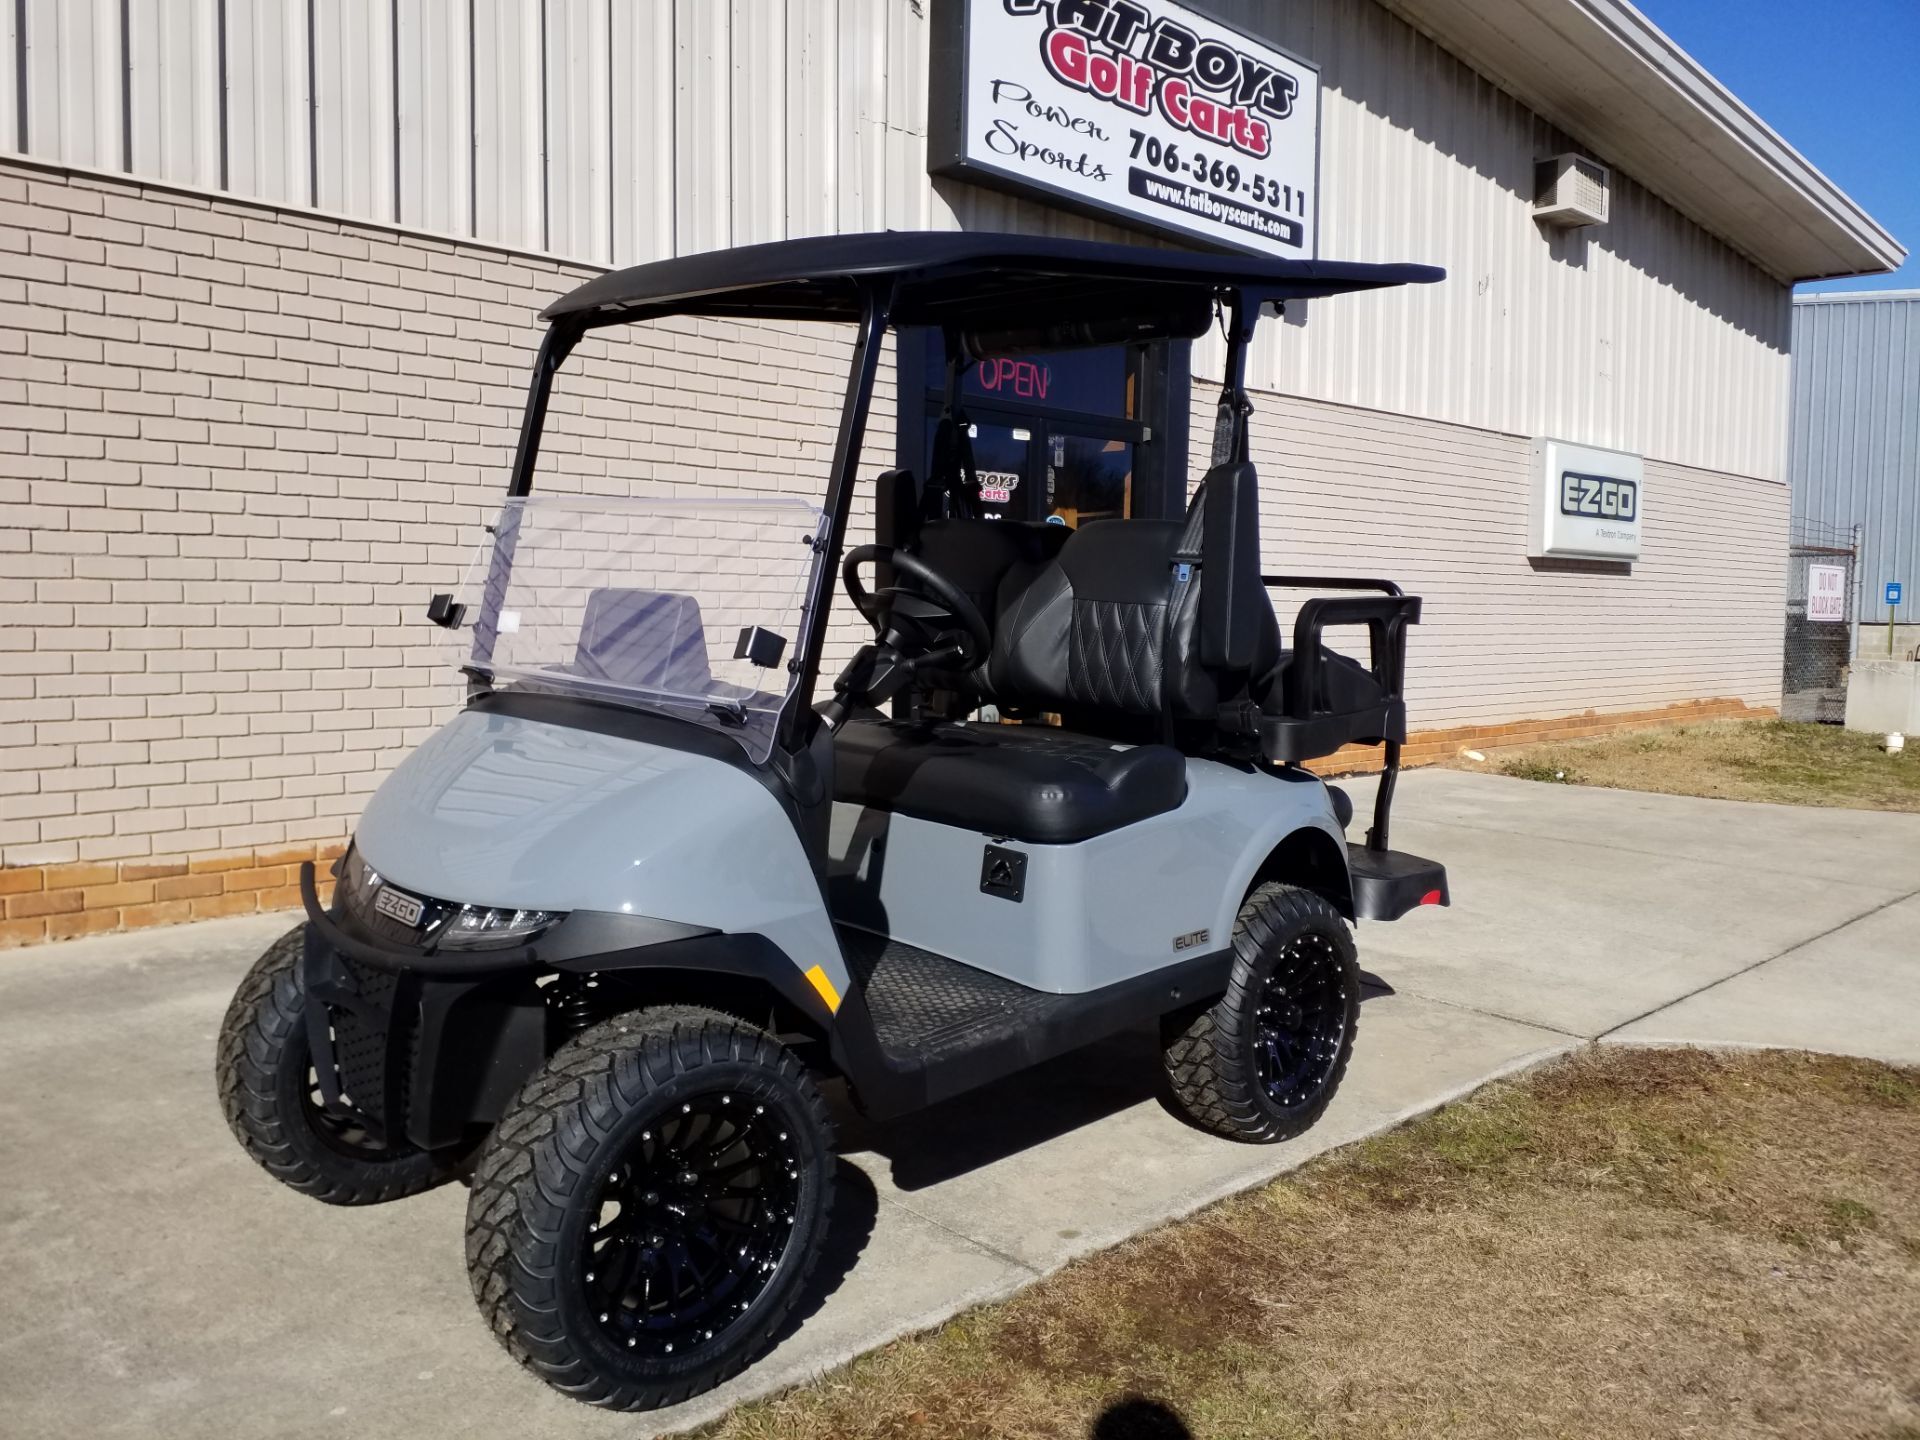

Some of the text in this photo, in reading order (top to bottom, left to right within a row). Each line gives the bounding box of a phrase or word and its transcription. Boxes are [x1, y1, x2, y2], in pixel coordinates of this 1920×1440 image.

[1003, 0, 1297, 116] AT BOYS
[990, 79, 1110, 142] Power
[1049, 29, 1270, 158] Golf Carts
[985, 119, 1112, 182] Sports
[1129, 129, 1305, 217] 706-369-5311
[1146, 179, 1291, 240] www.fatboyscarts.com
[979, 357, 1047, 399] OPEN
[1811, 595, 1829, 615] BLOCK
[1818, 572, 1839, 592] DO NOT
[377, 890, 420, 923] EZGO
[1174, 930, 1209, 950] ELITE
